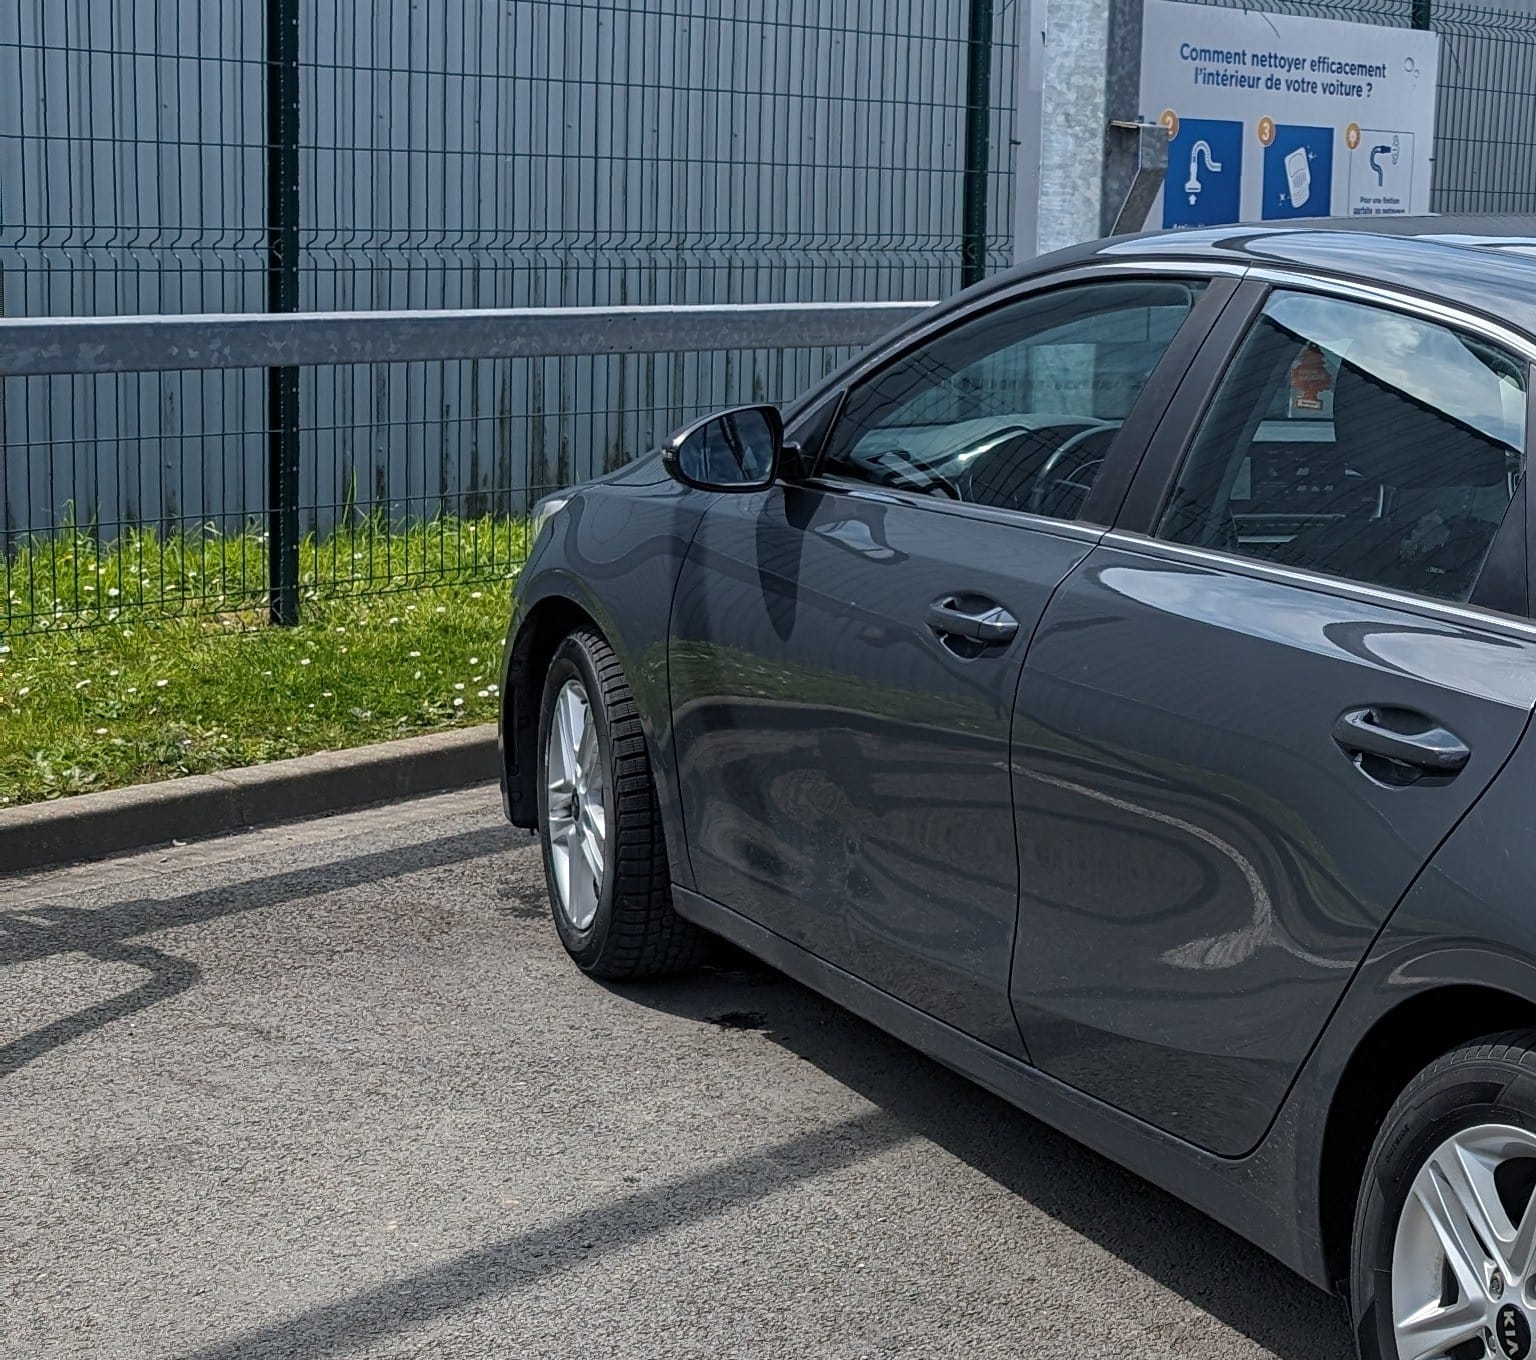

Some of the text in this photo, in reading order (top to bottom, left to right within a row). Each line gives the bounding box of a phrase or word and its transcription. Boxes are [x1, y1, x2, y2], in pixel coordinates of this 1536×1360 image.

[1179, 42, 1387, 79] Comment nettoyer efficacement
[1194, 67, 1374, 98] l'intérieur de votre voiture ?
[1503, 1310, 1519, 1356] KIA
